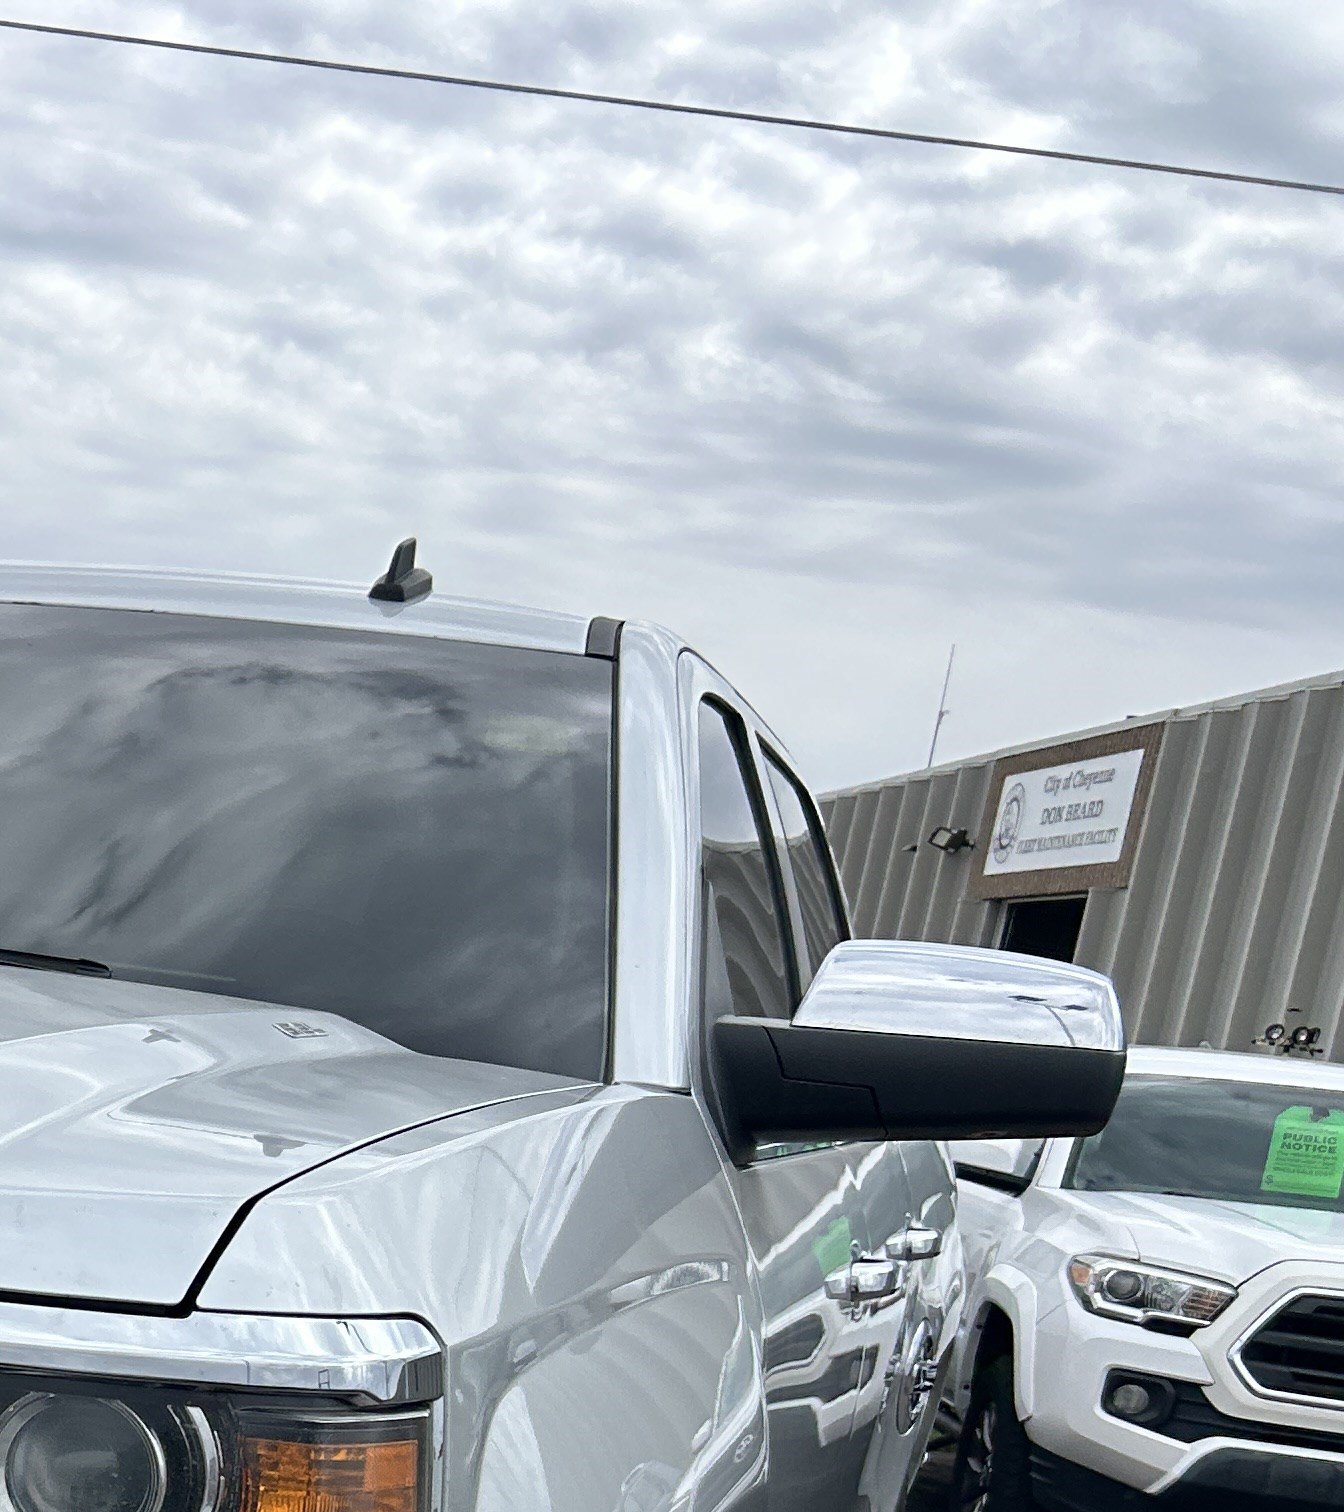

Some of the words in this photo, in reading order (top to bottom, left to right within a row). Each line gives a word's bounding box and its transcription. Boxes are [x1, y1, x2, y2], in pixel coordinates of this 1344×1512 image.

[1044, 775, 1062, 796] City
[1062, 771, 1073, 790] of
[1040, 806, 1065, 825] DON
[1065, 800, 1103, 821] BEARD
[1280, 1142, 1337, 1153] NOTICE
[1283, 1133, 1337, 1144] PUBLIC
